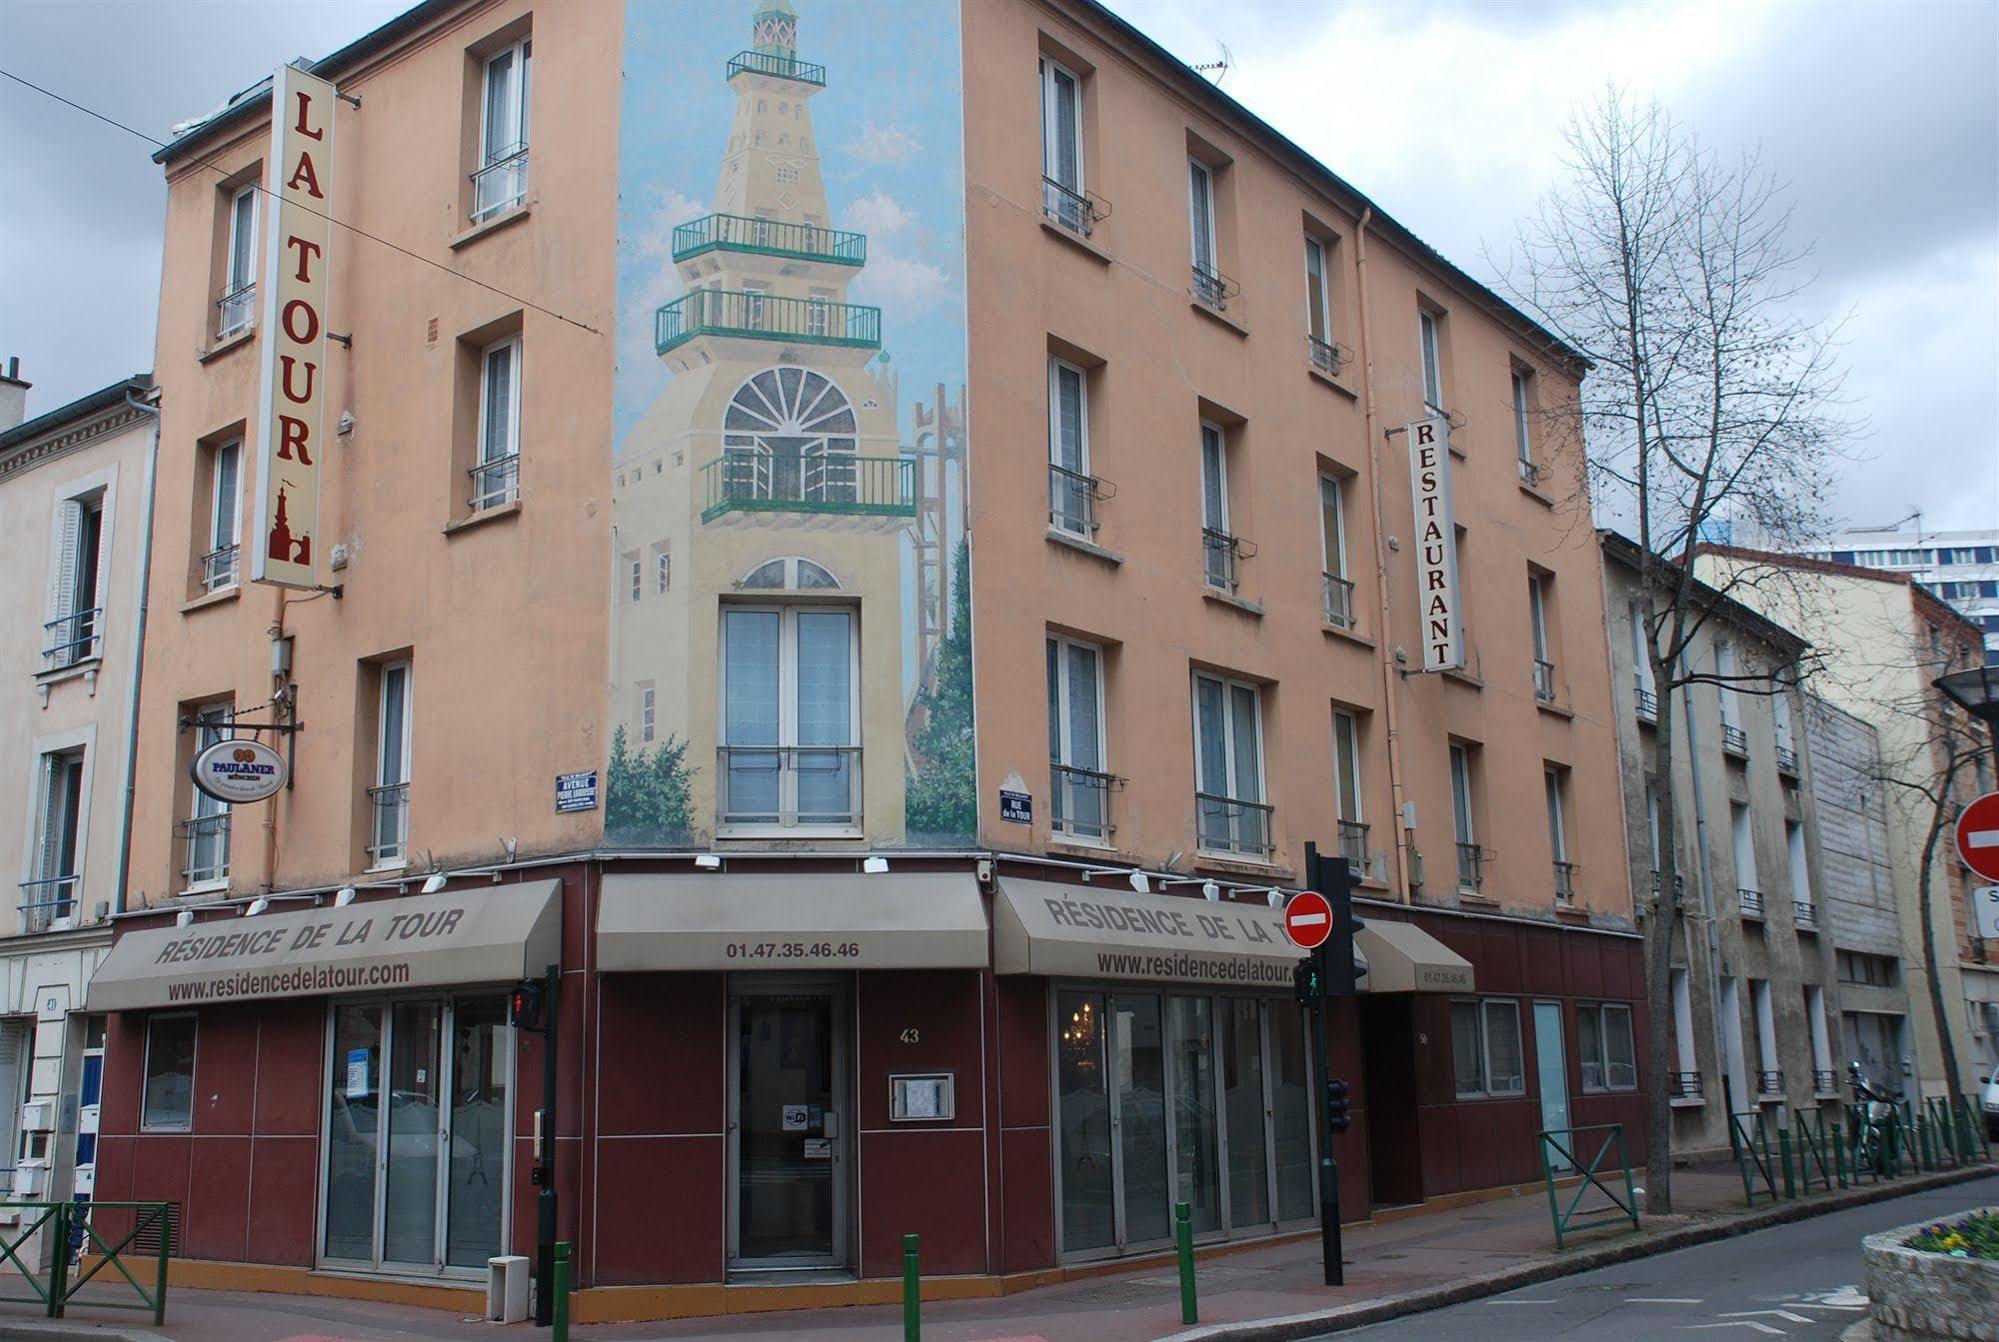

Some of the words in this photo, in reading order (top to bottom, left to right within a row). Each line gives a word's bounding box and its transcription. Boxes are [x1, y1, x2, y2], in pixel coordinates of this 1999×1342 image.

[286, 91, 324, 199] LA
[277, 235, 322, 466] TOUR
[1416, 424, 1449, 664] RESTAURANT
[212, 762, 275, 775] PAULANER
[562, 778, 590, 791] AVENUE
[1010, 799, 1022, 811] RUE
[1016, 809, 1031, 821] TOUR
[1043, 892, 1194, 937] RÉSIDENCE
[1195, 914, 1236, 941] DE
[1236, 918, 1274, 944] LA
[154, 928, 289, 965] RÉSIDENCE
[290, 922, 333, 950] DE
[336, 918, 376, 946] LA
[384, 908, 465, 942] TOUR
[726, 943, 860, 958] 01.47.35.46.46
[168, 962, 410, 1001] www.residencedelatour.com
[1097, 952, 1297, 983] www.residencedelatour.
[899, 1028, 920, 1044] 43
